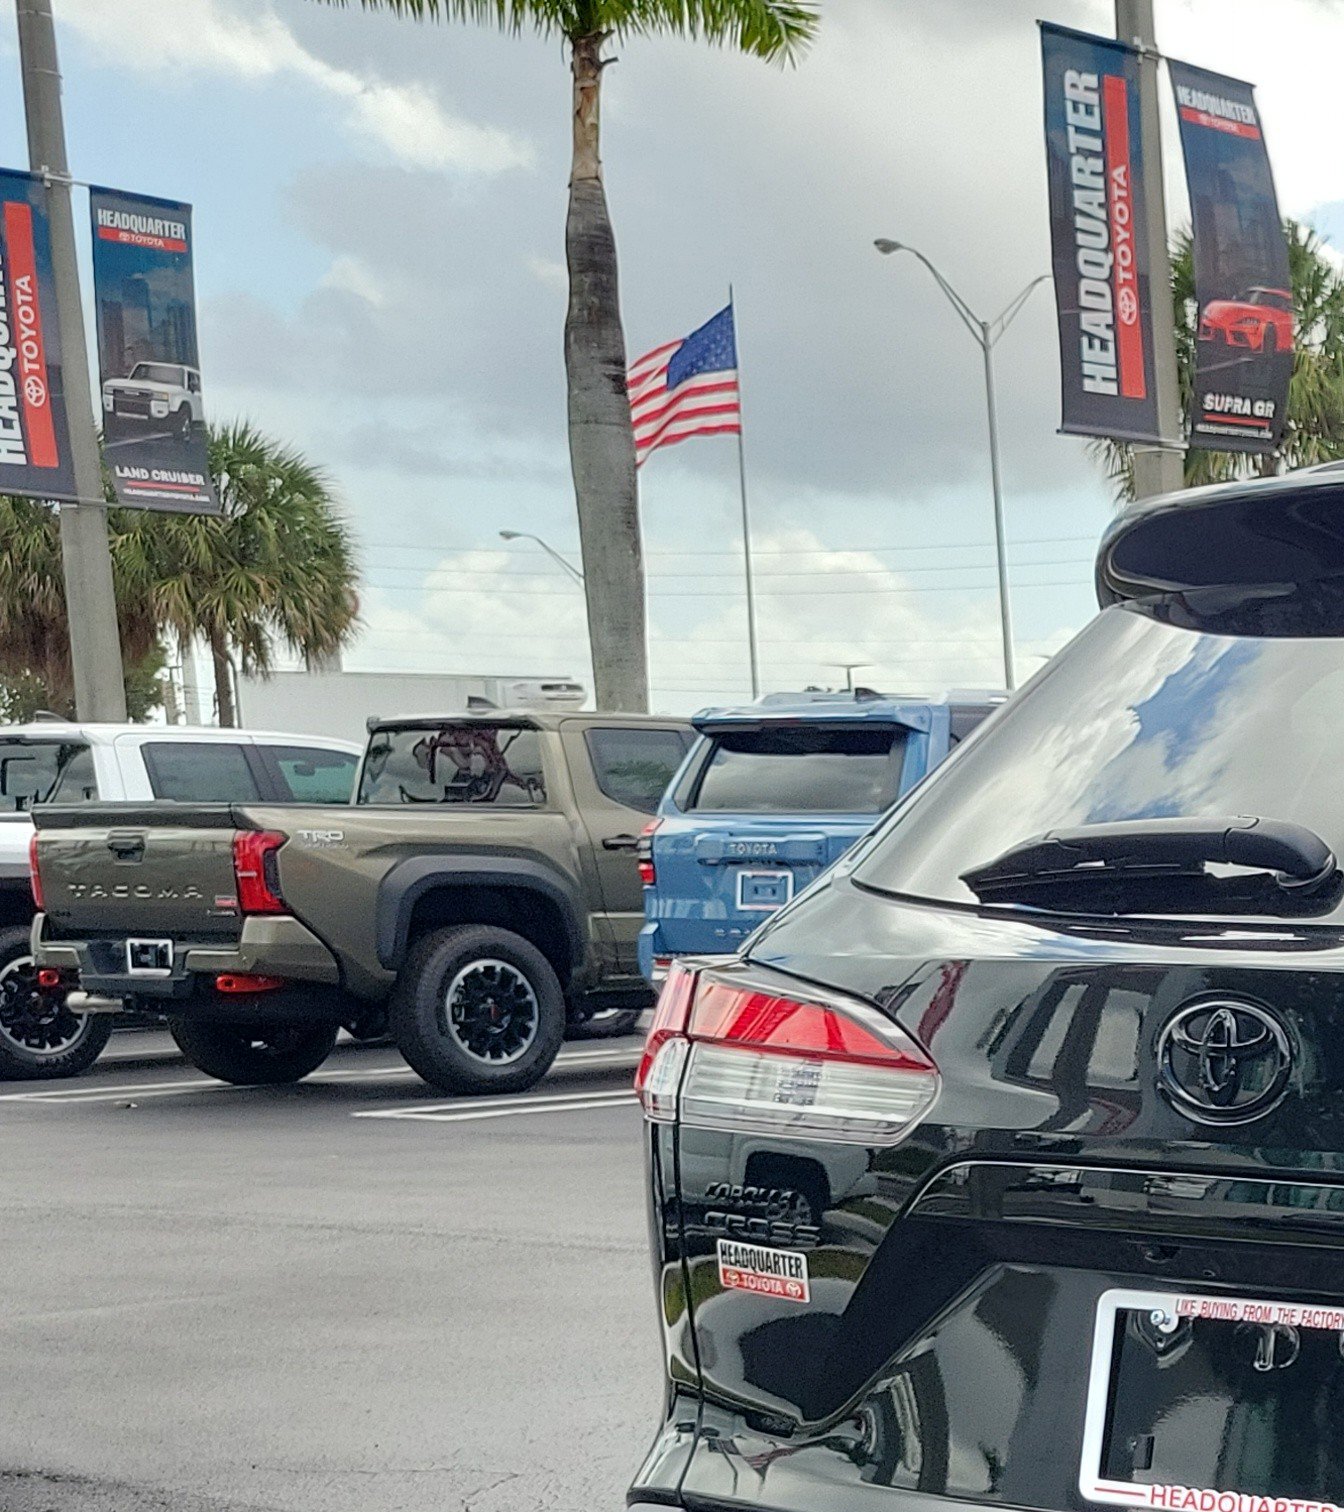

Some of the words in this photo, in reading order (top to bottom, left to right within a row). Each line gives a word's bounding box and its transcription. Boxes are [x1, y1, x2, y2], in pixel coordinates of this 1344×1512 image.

[97, 208, 186, 240] HEADQUARTER
[1065, 69, 1119, 396] HEADQUARTER
[1112, 164, 1133, 284] TOYOTA
[15, 275, 39, 372] TOYOTA
[1203, 392, 1251, 416] SUPRA
[115, 465, 149, 479] LAND
[151, 469, 205, 486] CRUISER
[730, 843, 777, 855] TOYOTA
[68, 884, 203, 898] TACOMA
[705, 1211, 820, 1247] CROSS
[720, 1242, 804, 1279] HEADQUARTER
[742, 1274, 785, 1295] TOYOTA
[1175, 1299, 1197, 1315] LIKE
[1200, 1301, 1238, 1320] BUYING
[1243, 1305, 1273, 1322] FROM
[1277, 1307, 1297, 1324] THE
